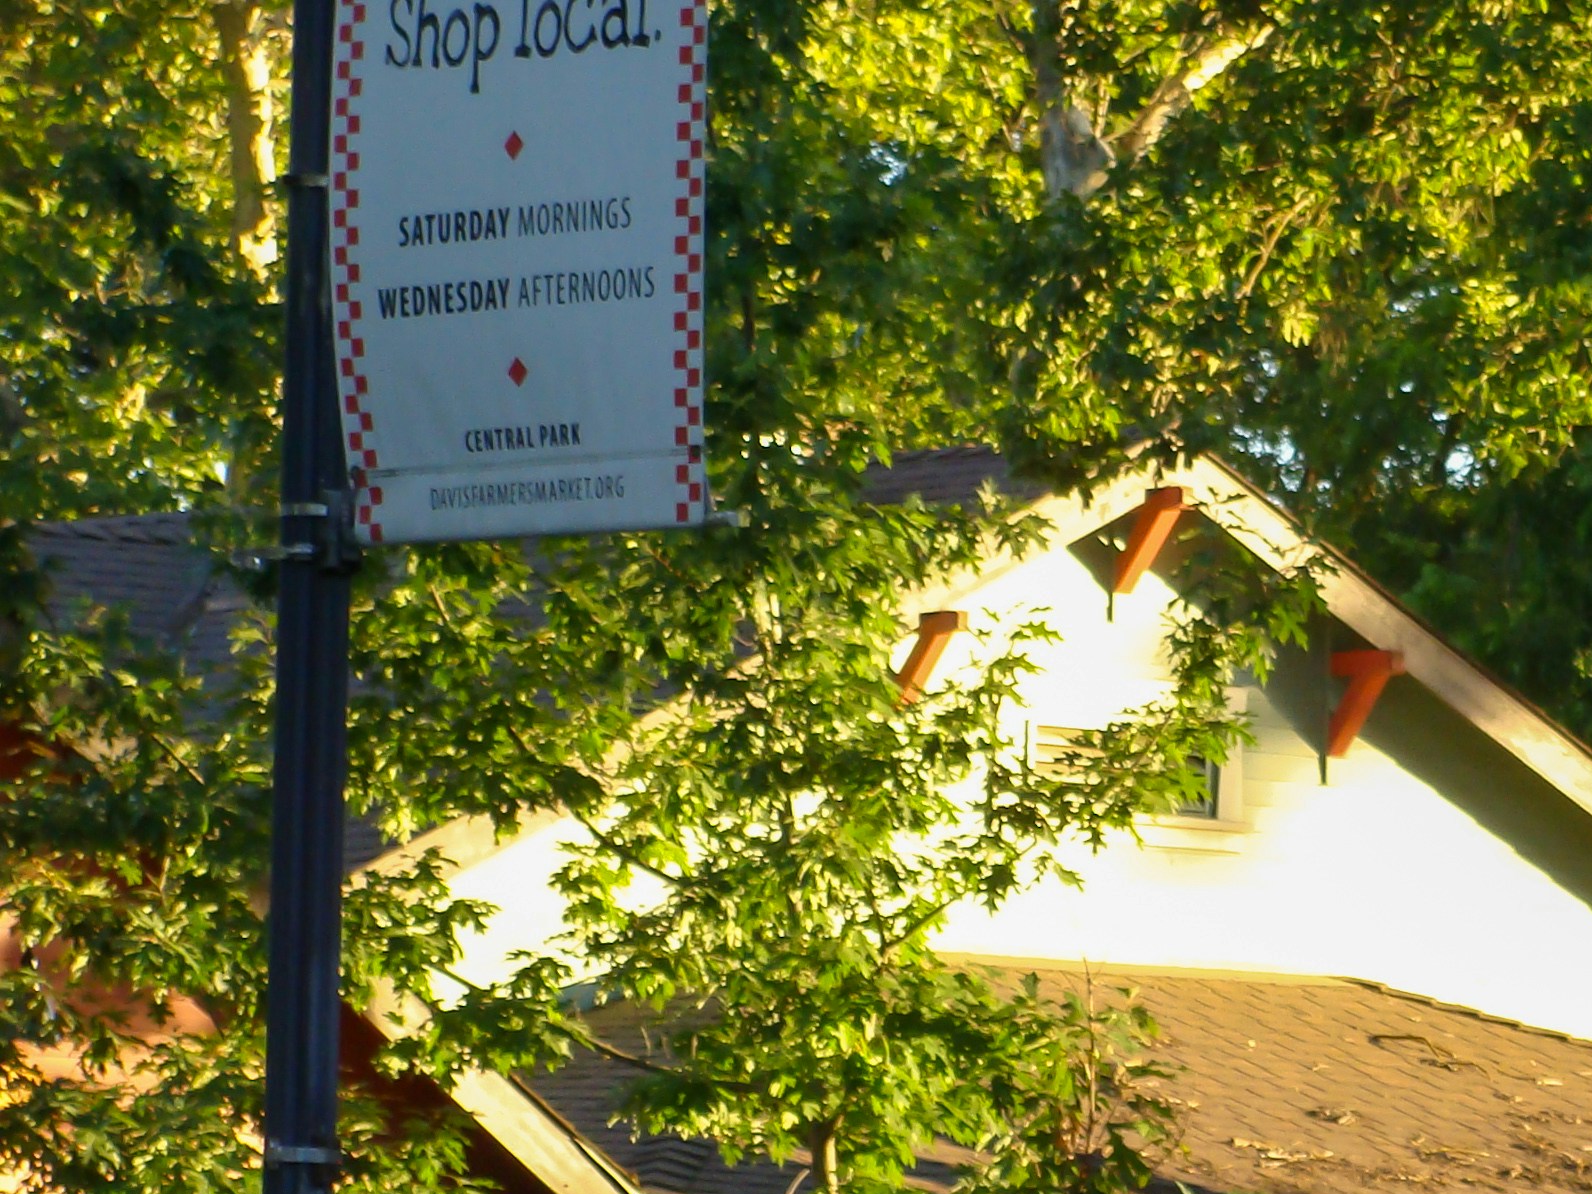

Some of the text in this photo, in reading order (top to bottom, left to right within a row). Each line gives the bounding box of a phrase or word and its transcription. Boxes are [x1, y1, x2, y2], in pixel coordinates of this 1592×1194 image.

[385, 0, 661, 93] Shop local.
[399, 197, 632, 247] SATURDAY MORNINGS
[378, 266, 655, 319] WEDNESDAY AFTERNOONS
[465, 423, 581, 453] CENTRAL PARK
[430, 475, 625, 511] DAVISFARMERSMARKET.ORG
